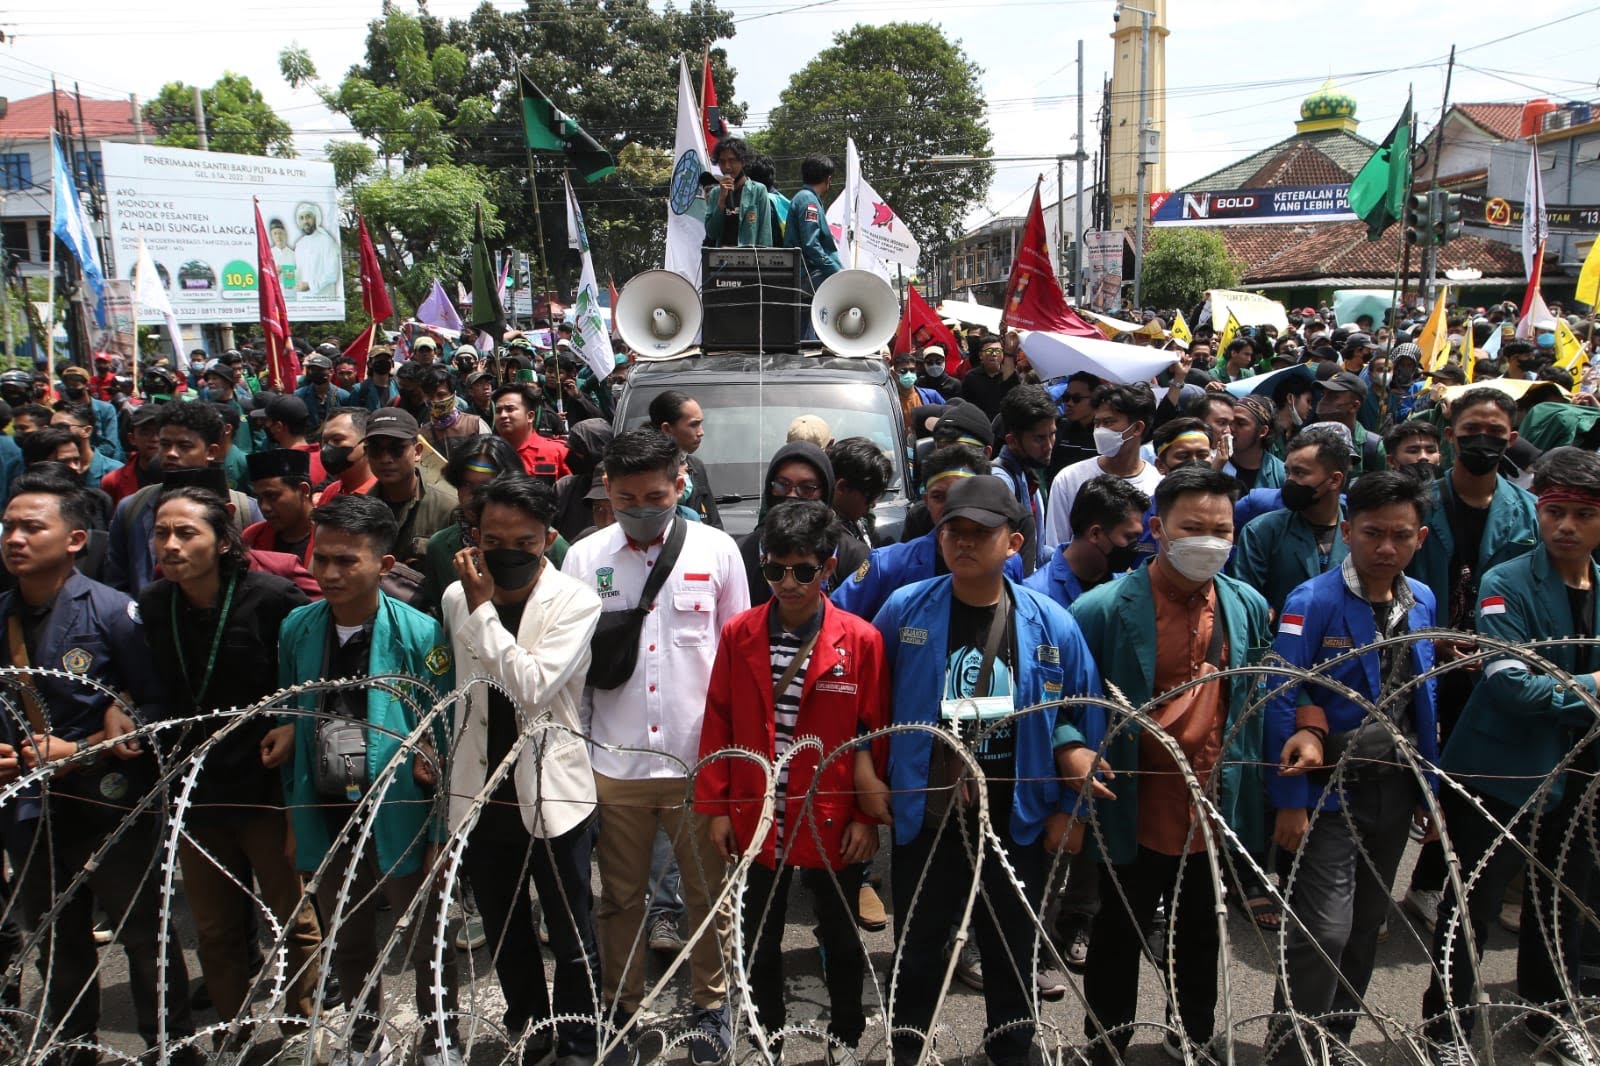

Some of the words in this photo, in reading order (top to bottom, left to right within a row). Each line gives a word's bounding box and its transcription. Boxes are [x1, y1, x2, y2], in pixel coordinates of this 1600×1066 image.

[143, 155, 200, 169] PENERIMAAN
[202, 161, 230, 171] SANTRI
[231, 163, 252, 173] BARU
[253, 165, 278, 175] PUTRA
[286, 168, 306, 177] PUTRI
[116, 188, 136, 197] AYO
[1273, 189, 1333, 202] KETEBALAN
[1335, 188, 1349, 199] RA
[117, 199, 160, 208] MONDOK
[162, 201, 174, 209] KE
[1150, 194, 1164, 211] NEW
[1216, 196, 1254, 209] BOLD
[1273, 200, 1300, 212] YANG
[1303, 199, 1334, 211] LEBIH
[1336, 199, 1351, 209] PU
[118, 209, 158, 219] PONDOK
[160, 211, 209, 221] PESANTREN
[120, 221, 136, 231] AL
[138, 222, 165, 232] HADI
[168, 223, 210, 234] SUNGAI
[226, 273, 254, 288] 10,6
[716, 279, 742, 288] Laney
